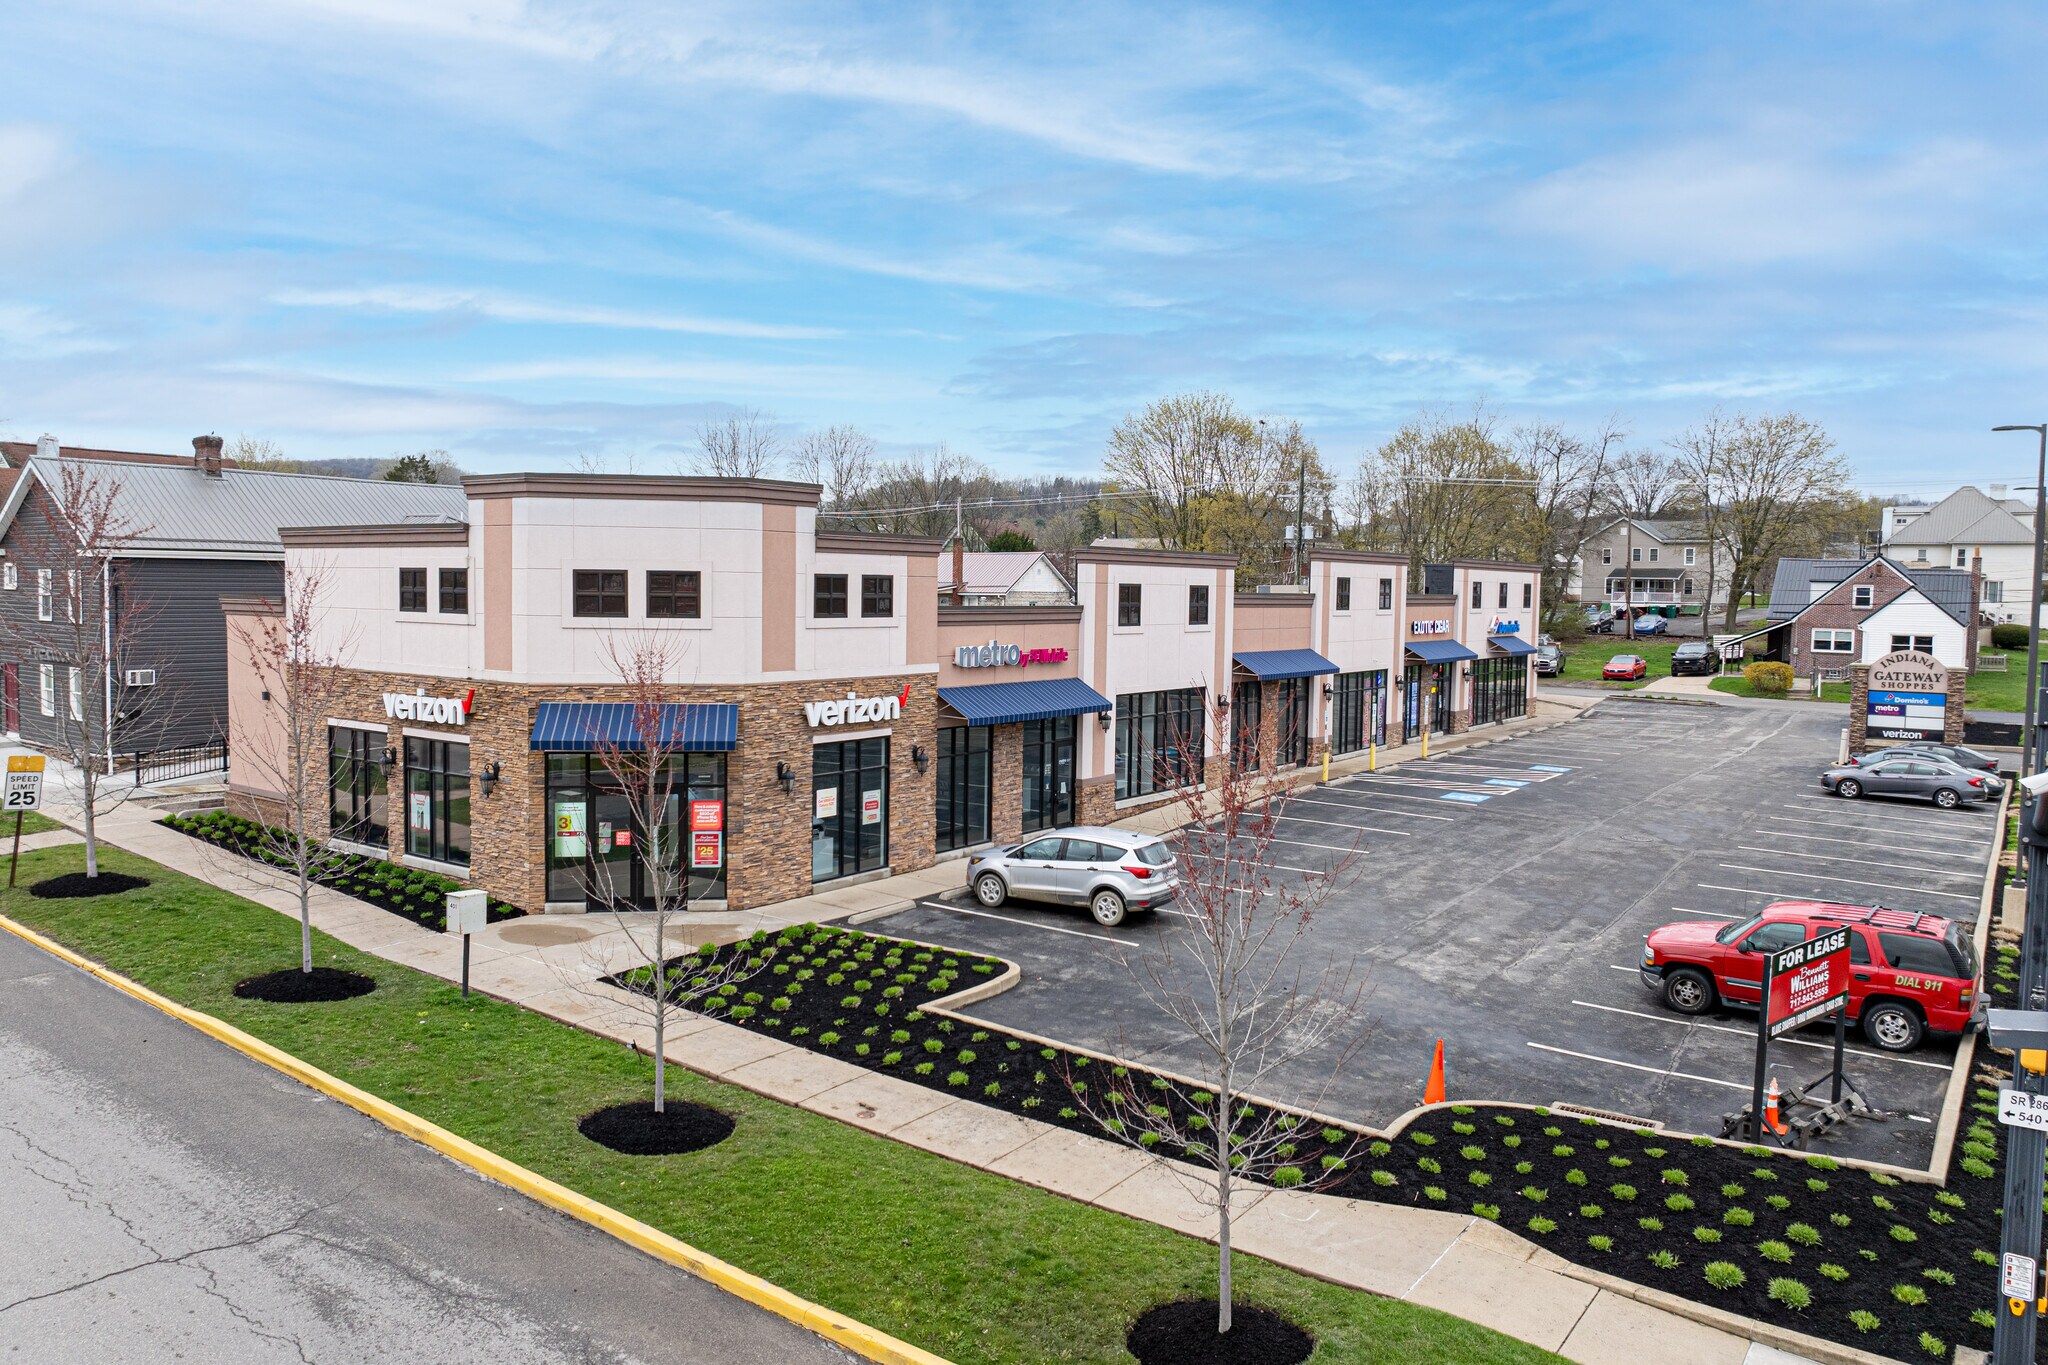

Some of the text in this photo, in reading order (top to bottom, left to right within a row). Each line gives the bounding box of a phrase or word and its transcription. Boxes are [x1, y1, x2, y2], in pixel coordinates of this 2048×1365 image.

[1412, 620, 1434, 634] EXOTIC
[955, 639, 1021, 668] metro
[1880, 654, 1935, 670] INDIANA
[1874, 670, 1944, 683] GATEWAY
[1880, 682, 1934, 690] SHOPPES
[382, 688, 466, 726] verizon
[1894, 696, 1929, 704] Domino's
[804, 692, 900, 728] verizon
[1882, 729, 1922, 740] verizon
[8, 791, 36, 806] 25
[1778, 932, 1846, 972] FOR LEASE
[1799, 960, 1830, 980] Bennett
[1790, 970, 1830, 994] WILLIAMS
[1895, 975, 1943, 992] DIAL 911
[1789, 986, 1829, 1009] 717-843-5555
[2010, 1095, 2026, 1106] SR
[2018, 1112, 2042, 1124] 540
